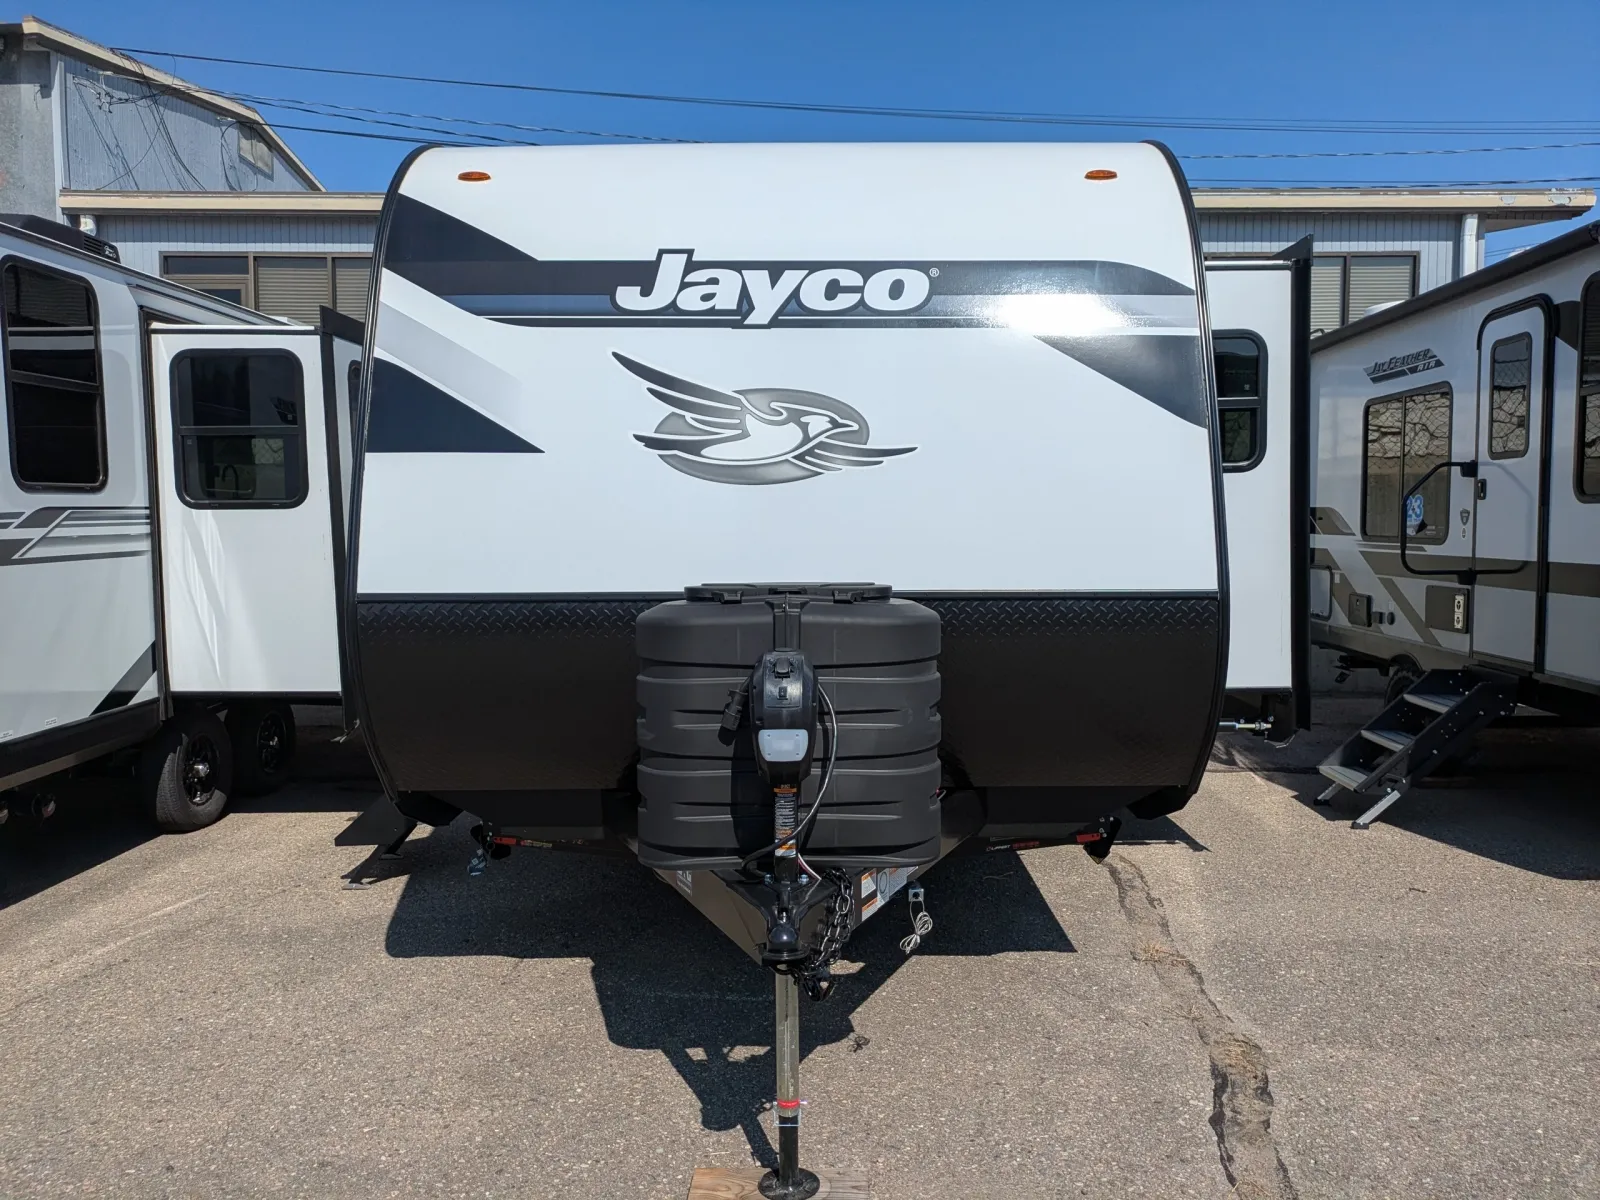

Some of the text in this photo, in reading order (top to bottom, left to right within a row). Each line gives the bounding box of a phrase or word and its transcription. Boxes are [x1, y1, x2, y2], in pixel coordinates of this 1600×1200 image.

[614, 251, 932, 326] Jayco
[1388, 348, 1431, 369] FEATHER
[1416, 360, 1436, 372] AIR
